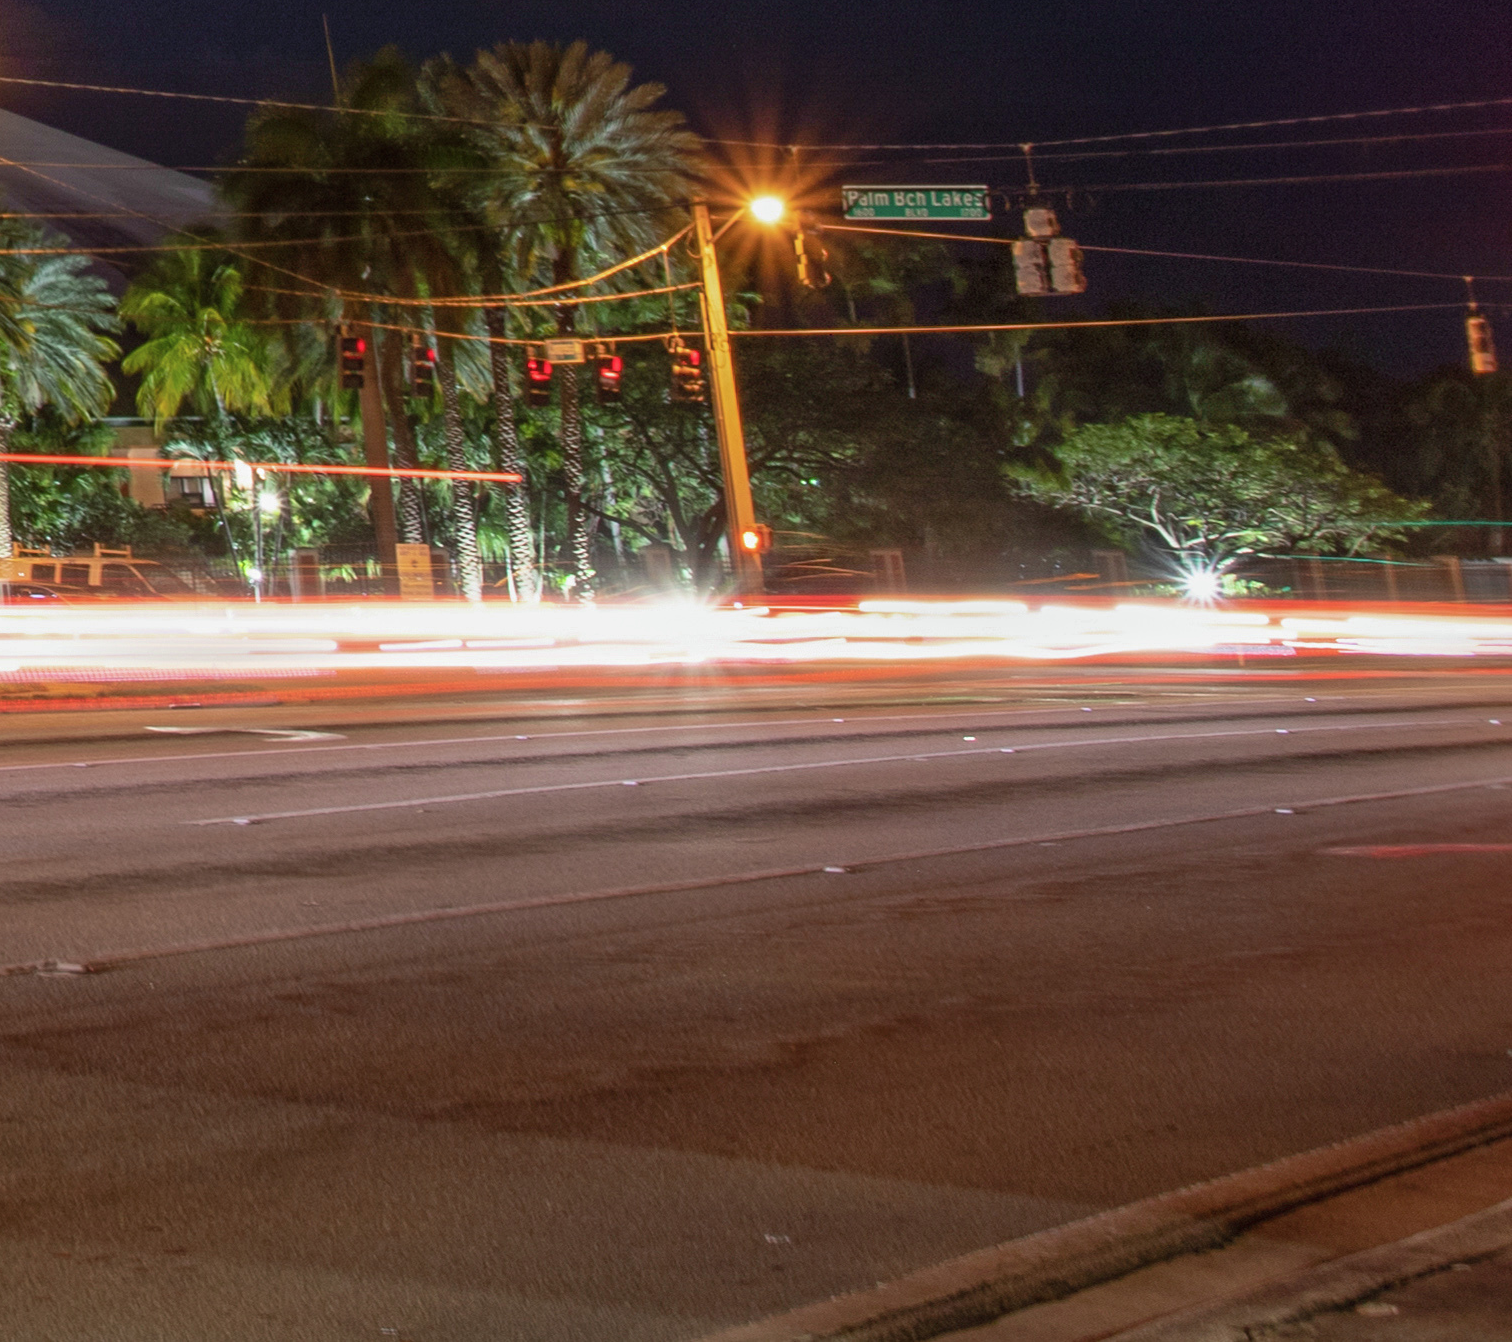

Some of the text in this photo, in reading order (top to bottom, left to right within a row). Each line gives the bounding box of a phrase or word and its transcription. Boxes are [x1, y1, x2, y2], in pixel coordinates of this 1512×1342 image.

[848, 190, 984, 207] Palm Bch Lakes
